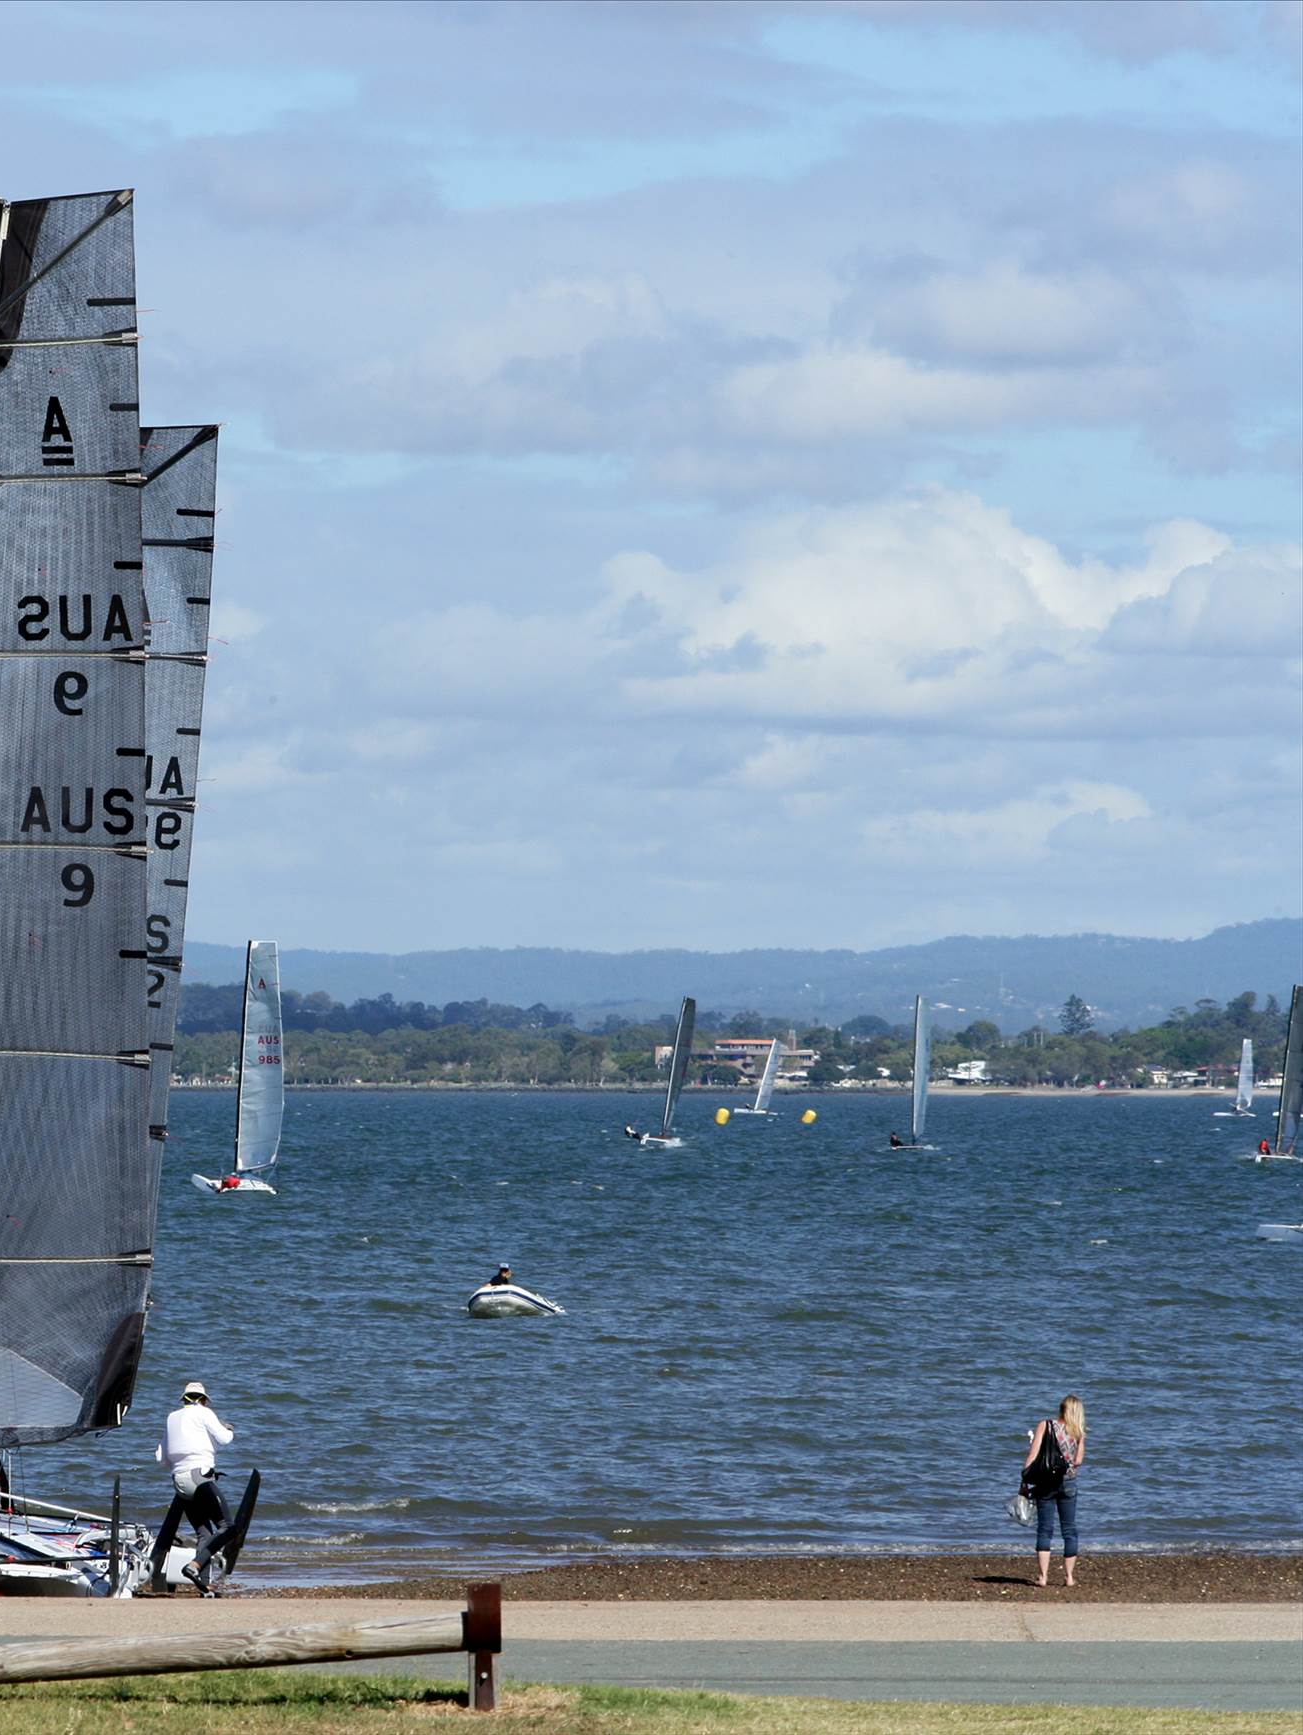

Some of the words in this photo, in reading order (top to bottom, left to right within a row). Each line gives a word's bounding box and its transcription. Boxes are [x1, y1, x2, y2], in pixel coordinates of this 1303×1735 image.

[42, 396, 73, 442] A
[20, 786, 134, 835] AUS
[61, 863, 95, 907] 9
[258, 1035, 280, 1045] AUS
